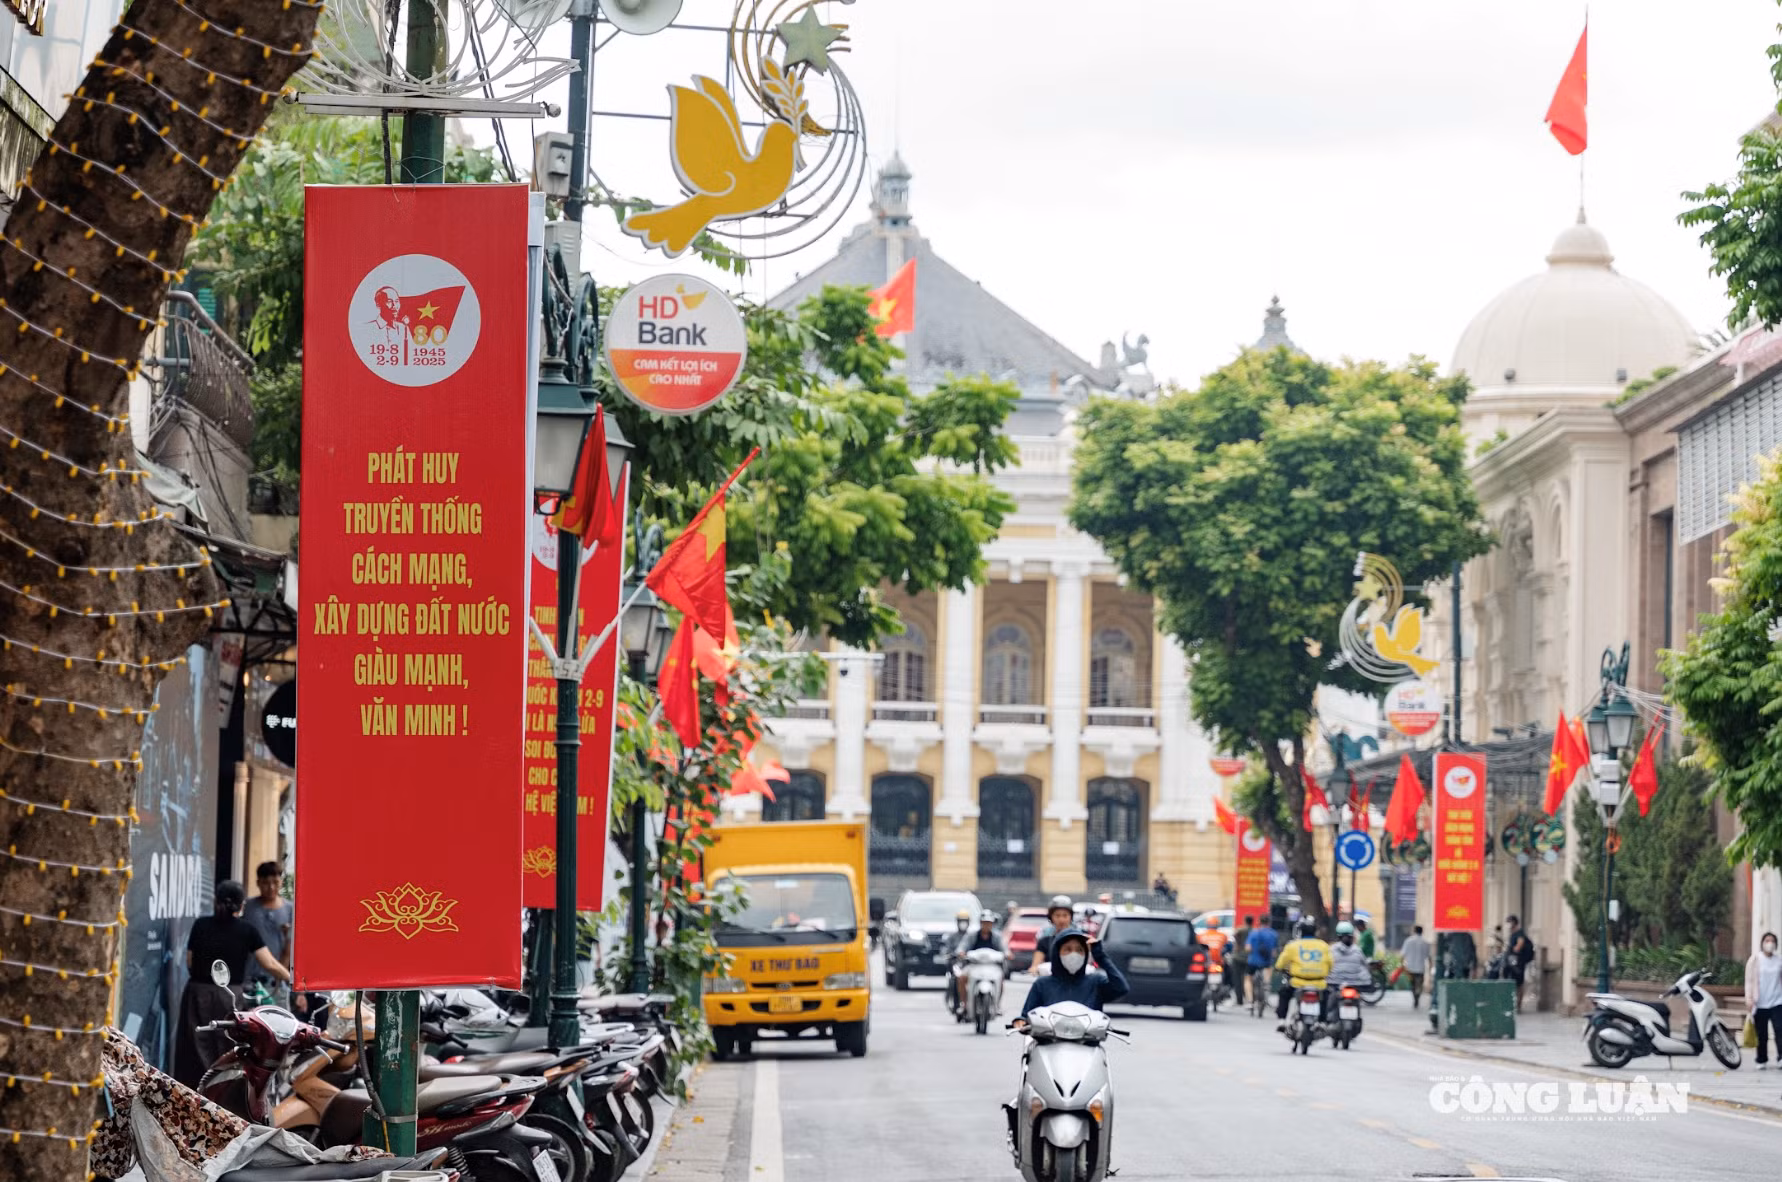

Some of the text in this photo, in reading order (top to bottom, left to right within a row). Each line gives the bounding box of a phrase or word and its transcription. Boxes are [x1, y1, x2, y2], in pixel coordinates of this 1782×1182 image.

[638, 295, 679, 319] HD
[413, 324, 448, 346] 80
[638, 321, 707, 346] Bank
[369, 344, 399, 355] 19-8
[413, 348, 446, 357] 1945
[376, 355, 399, 366] 2-9
[413, 357, 446, 366] 2025
[660, 356, 680, 371] KẾT
[700, 358, 718, 372] ÍCH
[649, 371, 703, 386] CAO NHẤT
[367, 445, 460, 484] PHÁT HUY
[343, 495, 482, 534] TRUYỀN THỐNG
[351, 545, 473, 591] CÁCH MẠNG,
[313, 594, 510, 642] XÂY DỰNG ĐẤT NƯỚC
[354, 646, 469, 692] GIÀU MẠNH,
[585, 688, 604, 708] 2-9
[360, 696, 398, 736] VĂN
[404, 704, 456, 736] MINH
[525, 739, 542, 758] SOI
[528, 766, 549, 785] CHO
[1299, 945, 1323, 962] be
